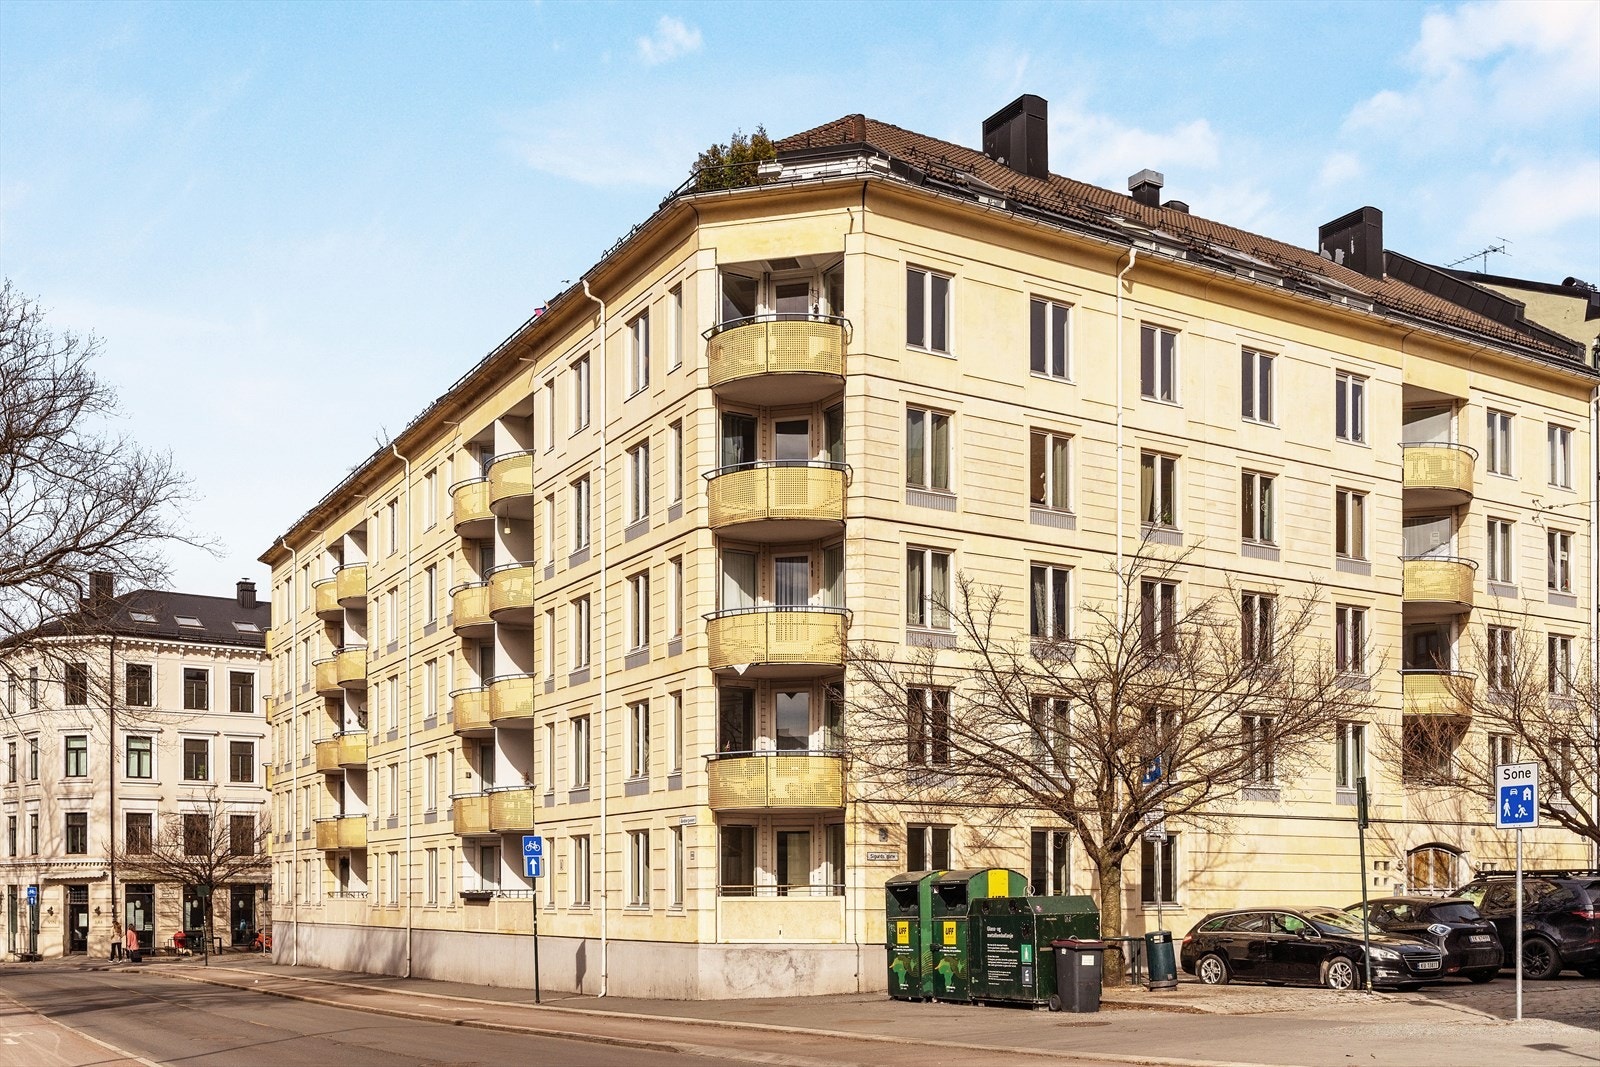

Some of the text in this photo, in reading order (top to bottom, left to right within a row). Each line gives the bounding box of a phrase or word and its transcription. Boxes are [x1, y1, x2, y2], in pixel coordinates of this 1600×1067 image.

[1503, 768, 1532, 780] Sone
[898, 927, 907, 935] UFF
[945, 927, 955, 935] UFF
